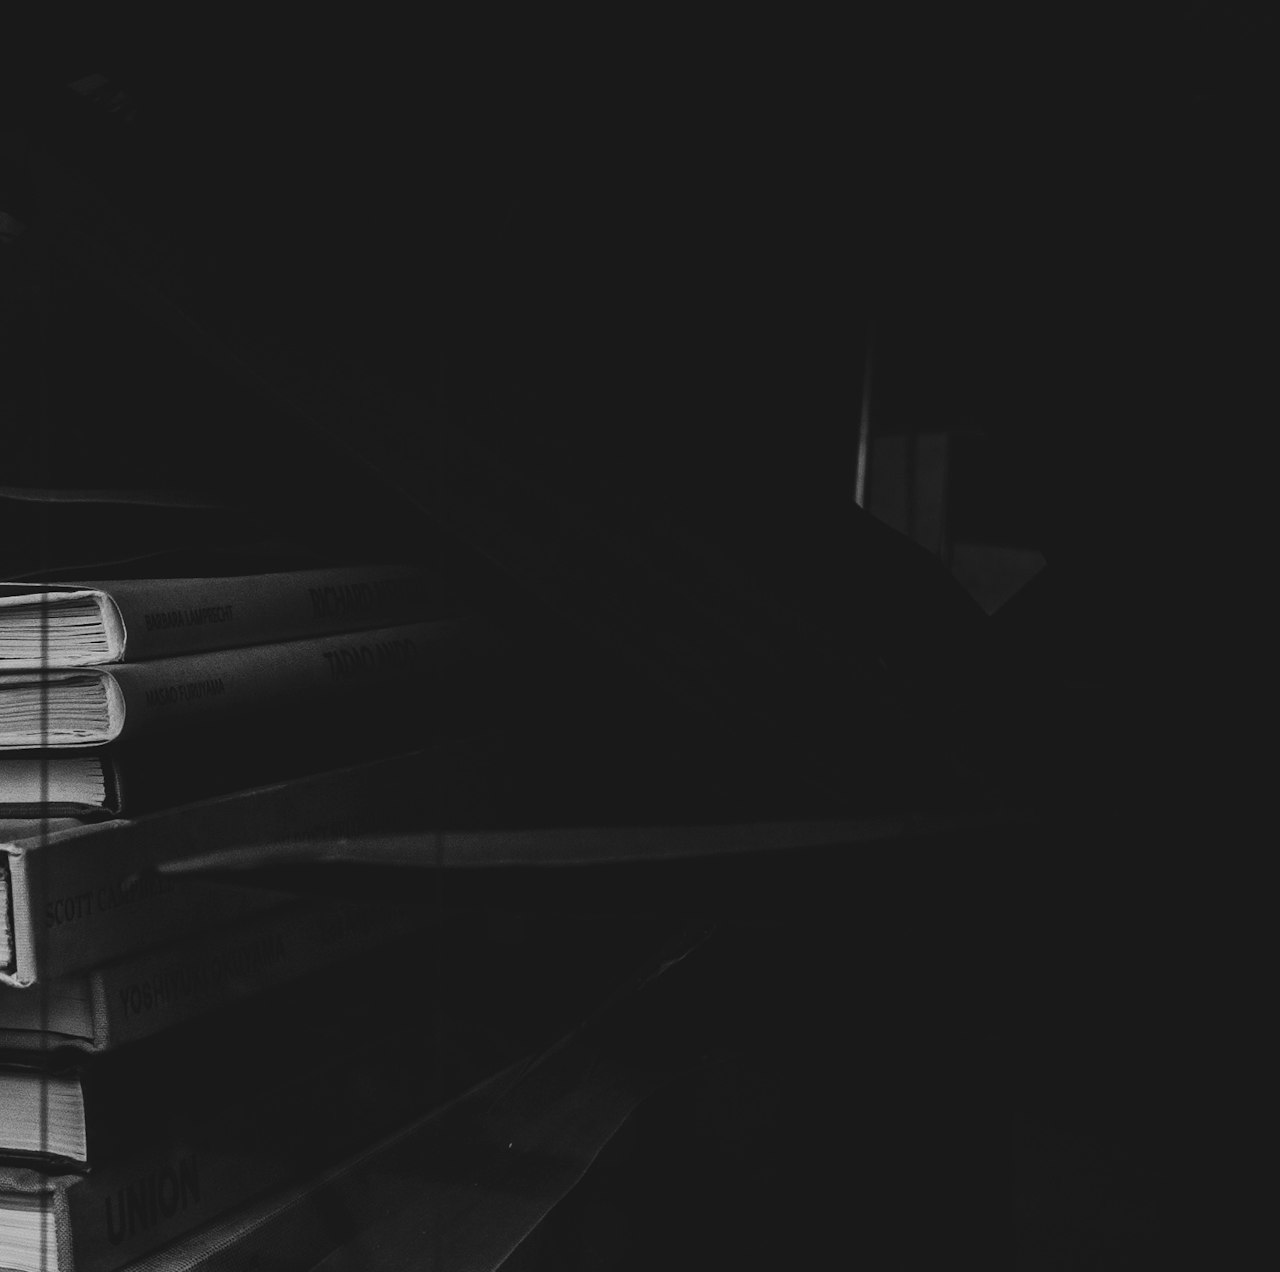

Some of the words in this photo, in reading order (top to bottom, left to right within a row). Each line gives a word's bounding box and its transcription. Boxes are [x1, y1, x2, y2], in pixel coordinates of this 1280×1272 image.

[45, 891, 95, 928] SCOTT
[119, 964, 208, 1018] YOSHIYUKI
[105, 1153, 200, 1246] UNION
